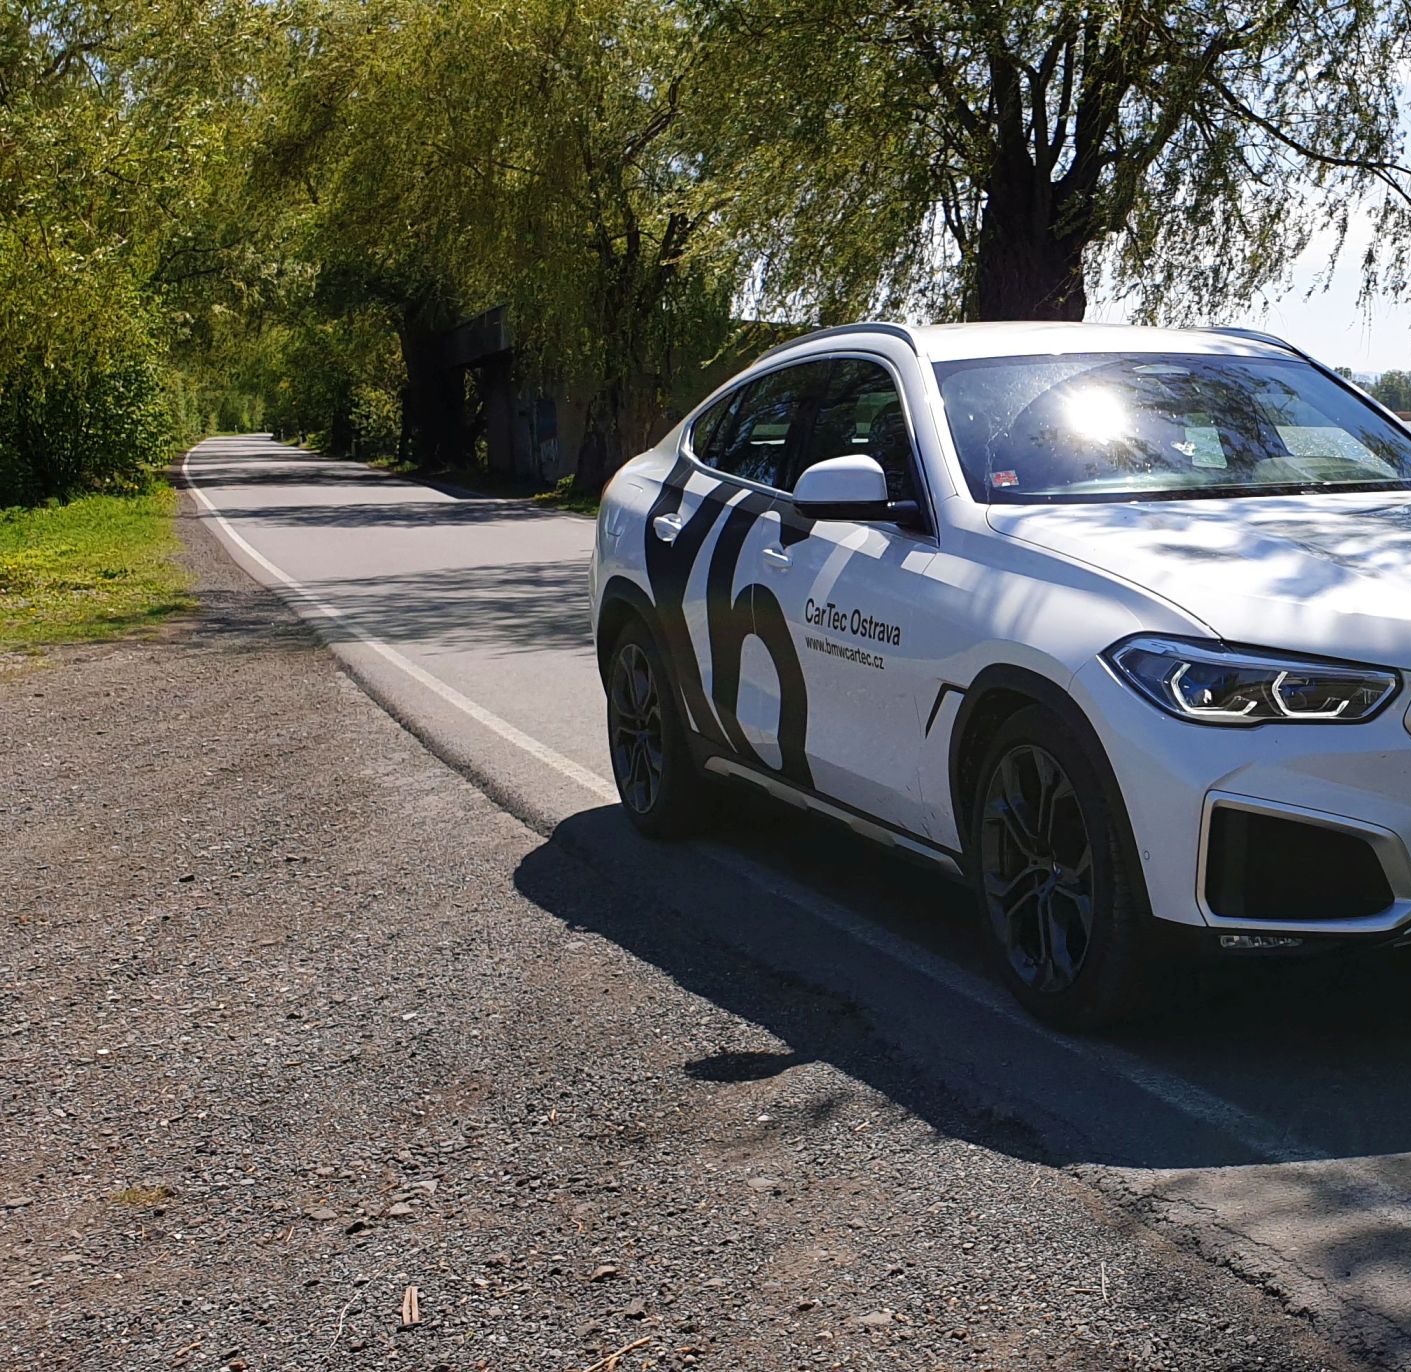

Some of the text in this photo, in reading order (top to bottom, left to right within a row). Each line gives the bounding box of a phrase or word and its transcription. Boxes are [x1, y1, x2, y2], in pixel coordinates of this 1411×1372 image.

[805, 598, 901, 646] CarTec Ostrava
[805, 637, 885, 670] www.bmwcartec.cz
